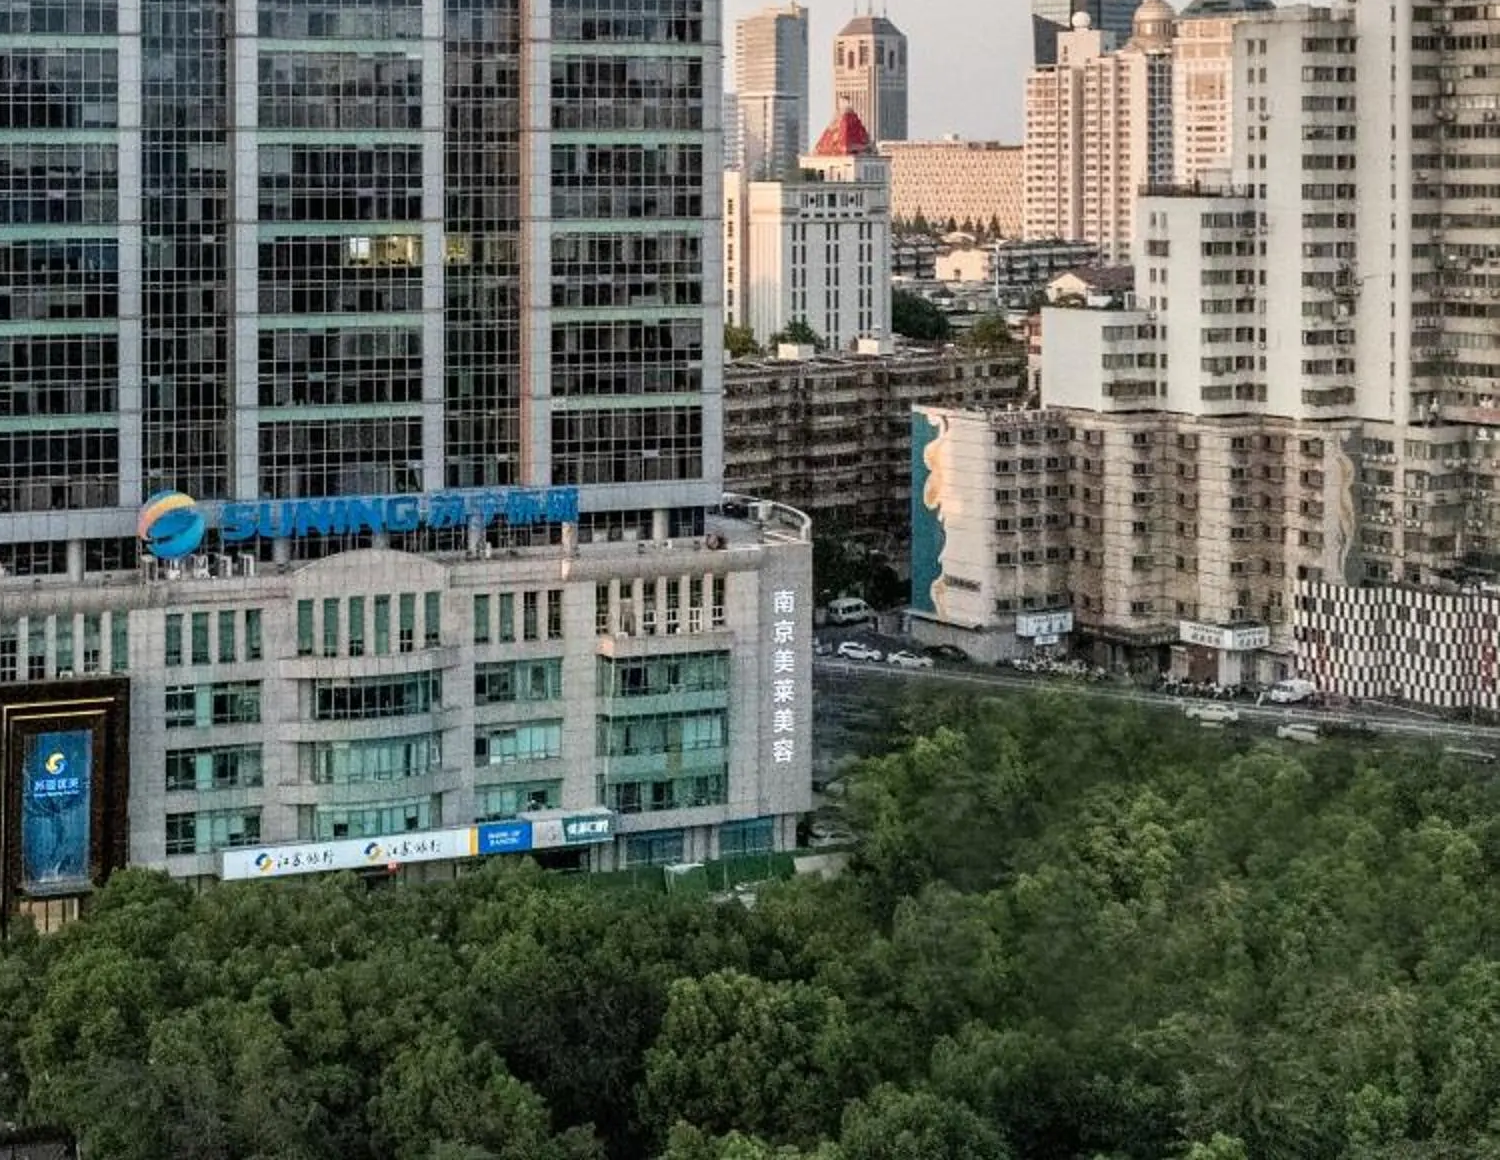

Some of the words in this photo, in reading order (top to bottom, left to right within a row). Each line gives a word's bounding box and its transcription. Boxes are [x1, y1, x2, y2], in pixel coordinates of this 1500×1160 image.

[219, 495, 420, 541] SUNING
[773, 589, 795, 763] 南京美莱美容
